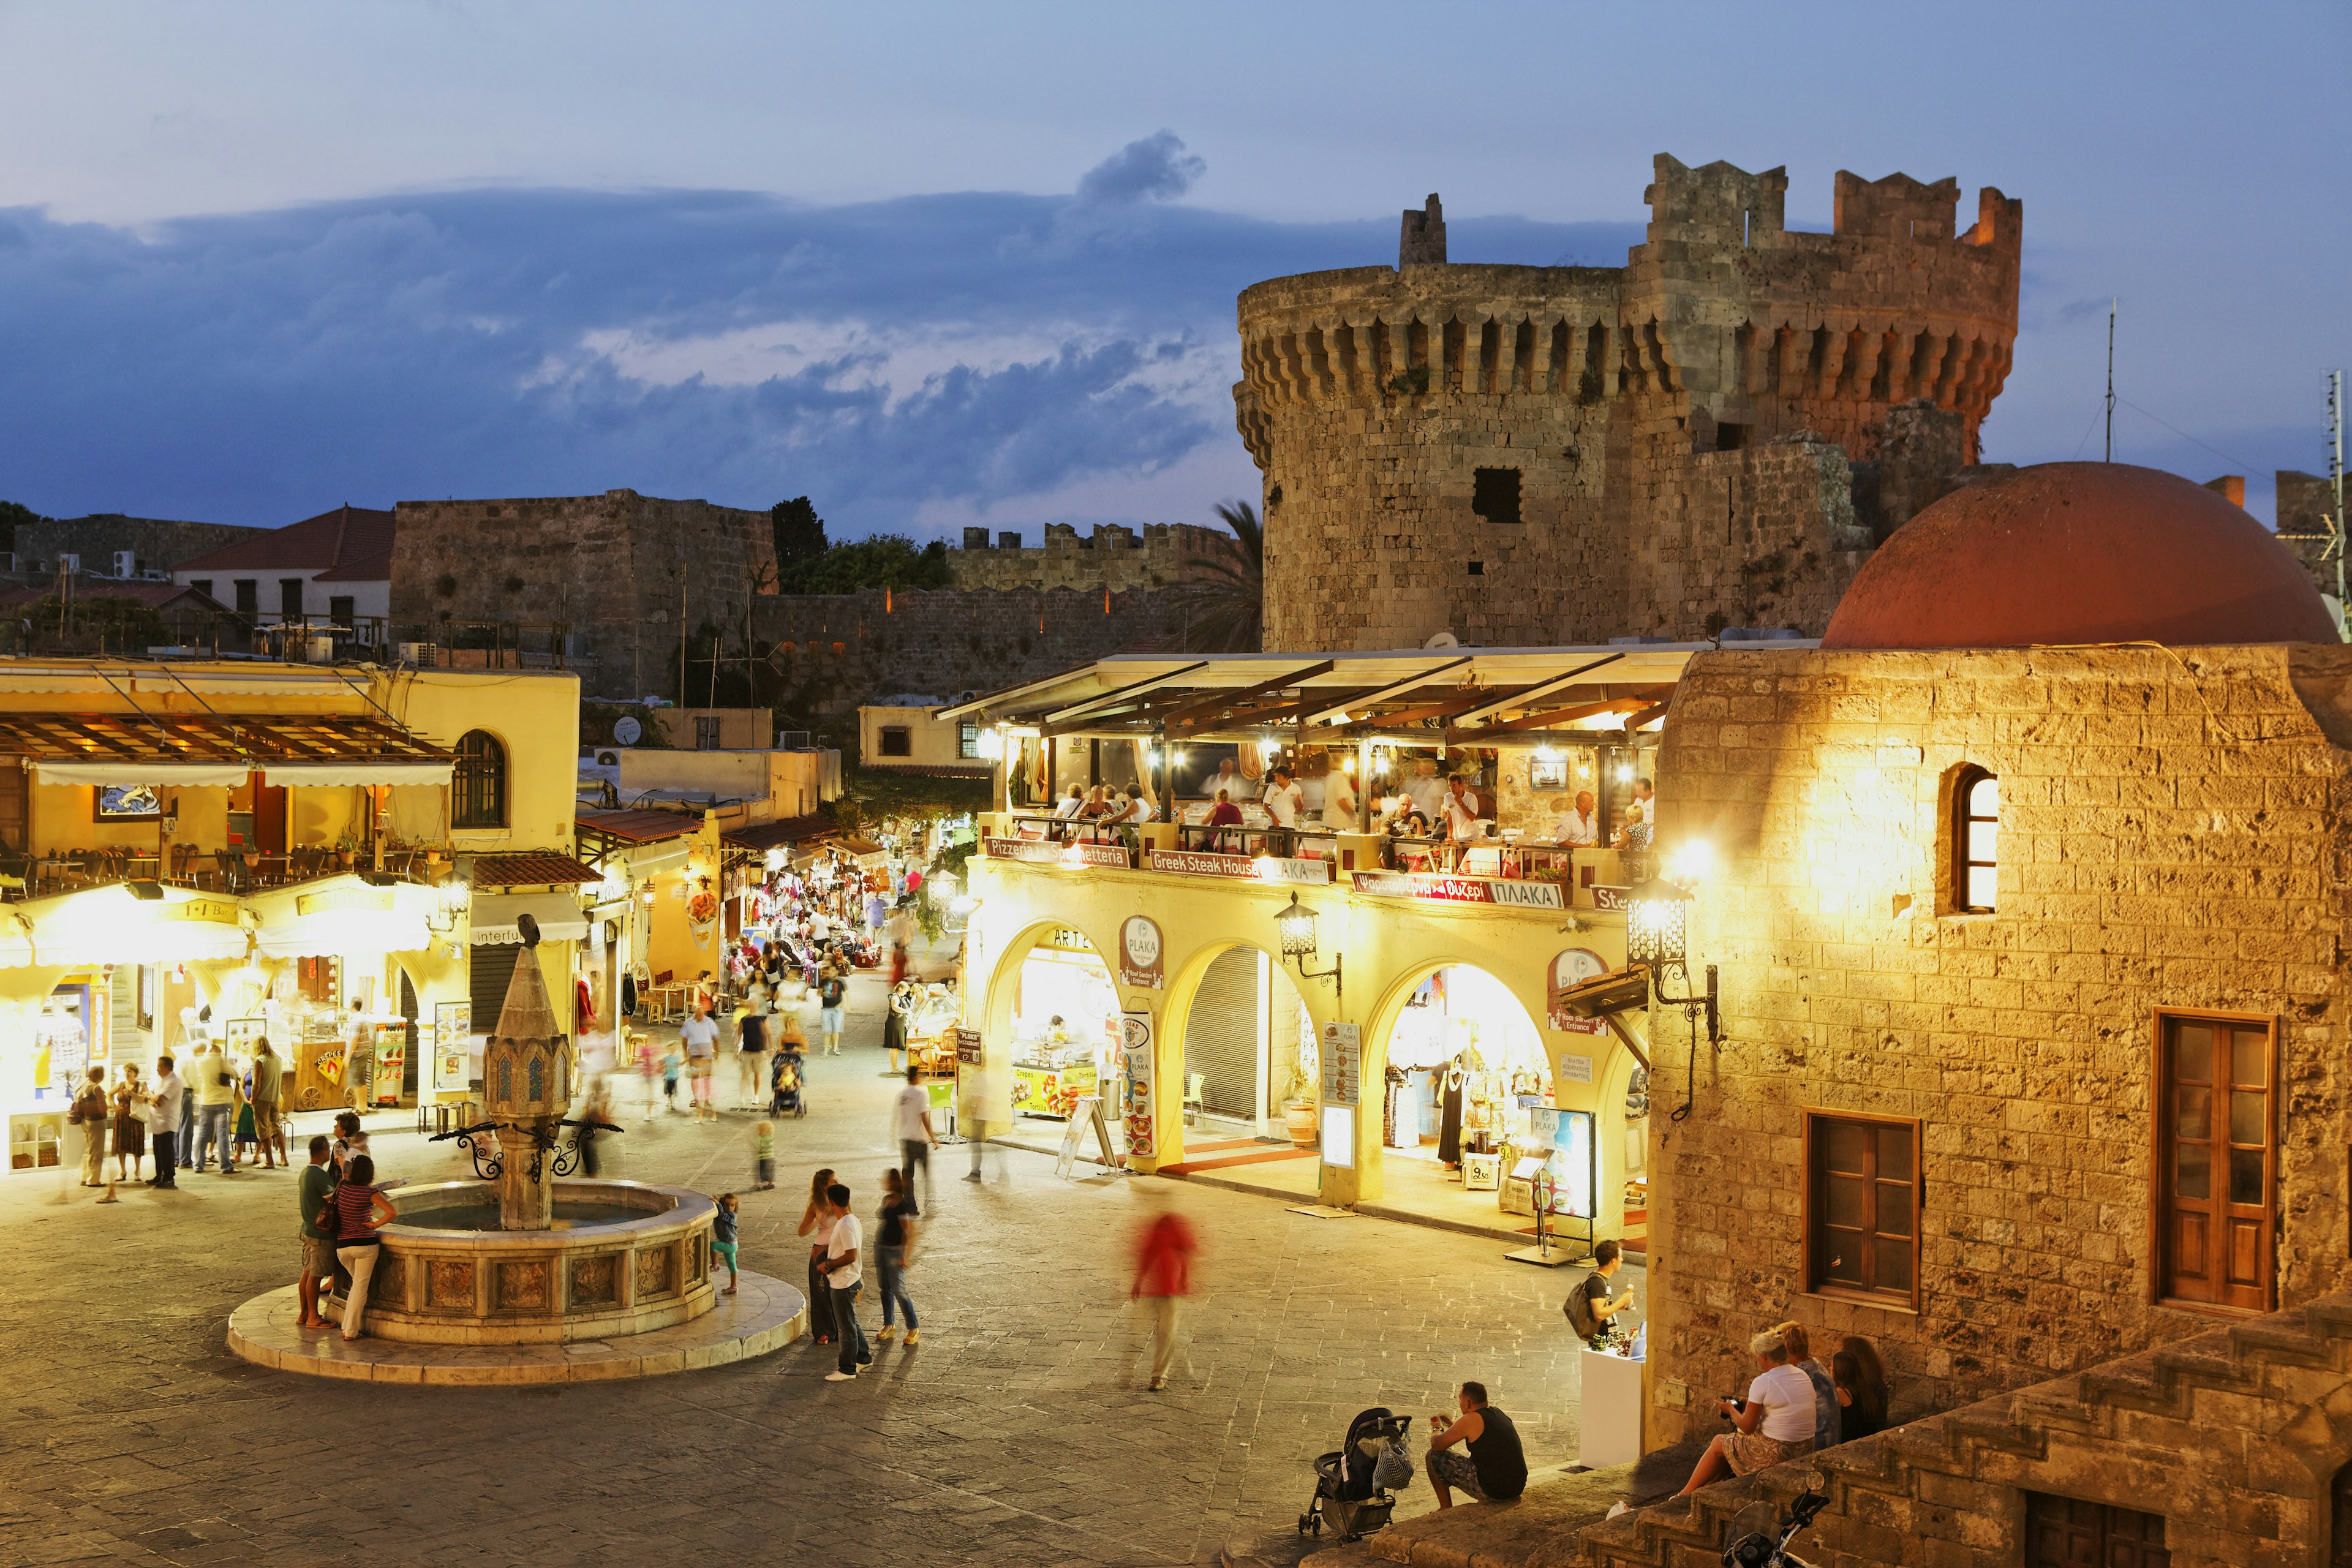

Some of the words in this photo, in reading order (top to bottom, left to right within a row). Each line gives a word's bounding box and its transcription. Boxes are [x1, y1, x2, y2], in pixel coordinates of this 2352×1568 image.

[992, 840, 1033, 856] Pizzeria
[1154, 853, 1186, 870] Greek
[1188, 856, 1221, 874] Steak
[1223, 858, 1259, 876] House
[1273, 862, 1309, 880] LAKA
[1359, 875, 1431, 896] Ψαροταβέρνα
[1496, 883, 1554, 905] ΠΛΑΚΑ
[1598, 889, 1627, 910] Ste
[213, 905, 228, 915] Bar
[1129, 939, 1156, 954] PLAKA
[1562, 976, 1580, 987] PLA
[1566, 1022, 1589, 1031] Entrance
[1017, 1069, 1034, 1078] Crepes
[1562, 1064, 1589, 1072] ΙΠΠΟΚΡΑΤΟΥΣ
[1030, 1102, 1047, 1112] Tortilla
[1536, 1121, 1556, 1132] PLAKA
